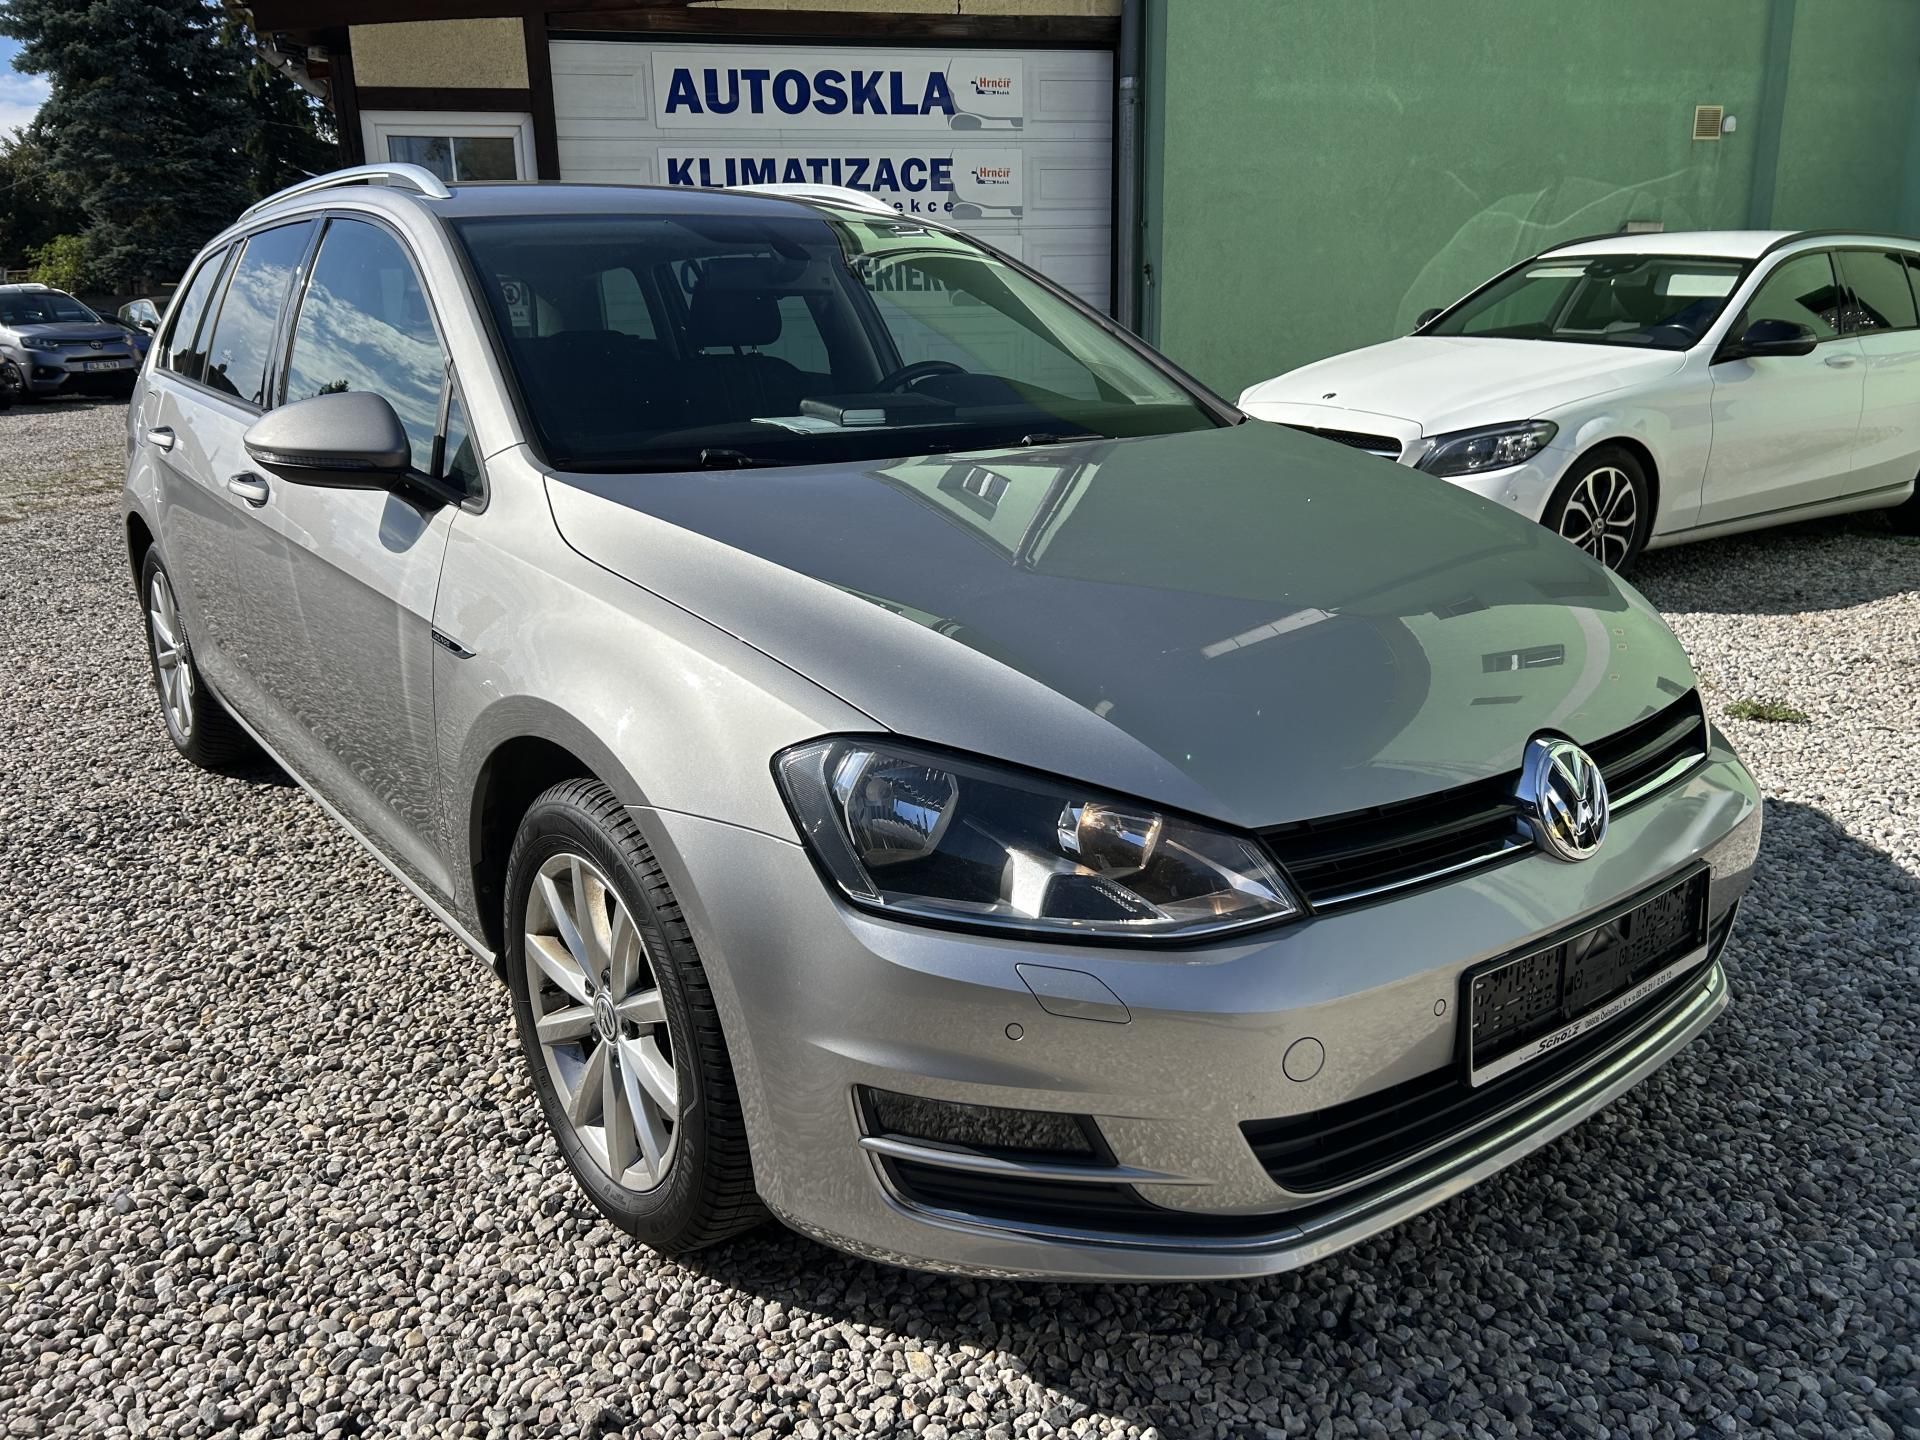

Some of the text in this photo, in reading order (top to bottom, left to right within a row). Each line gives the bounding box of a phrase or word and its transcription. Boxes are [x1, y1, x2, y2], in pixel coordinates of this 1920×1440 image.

[979, 76, 1011, 88] Hrnčíř
[665, 67, 956, 115] AUTOSKLA
[667, 157, 954, 193] KLIMATIZACE
[979, 167, 1011, 178] Hrnčíř
[879, 198, 954, 213] ekce
